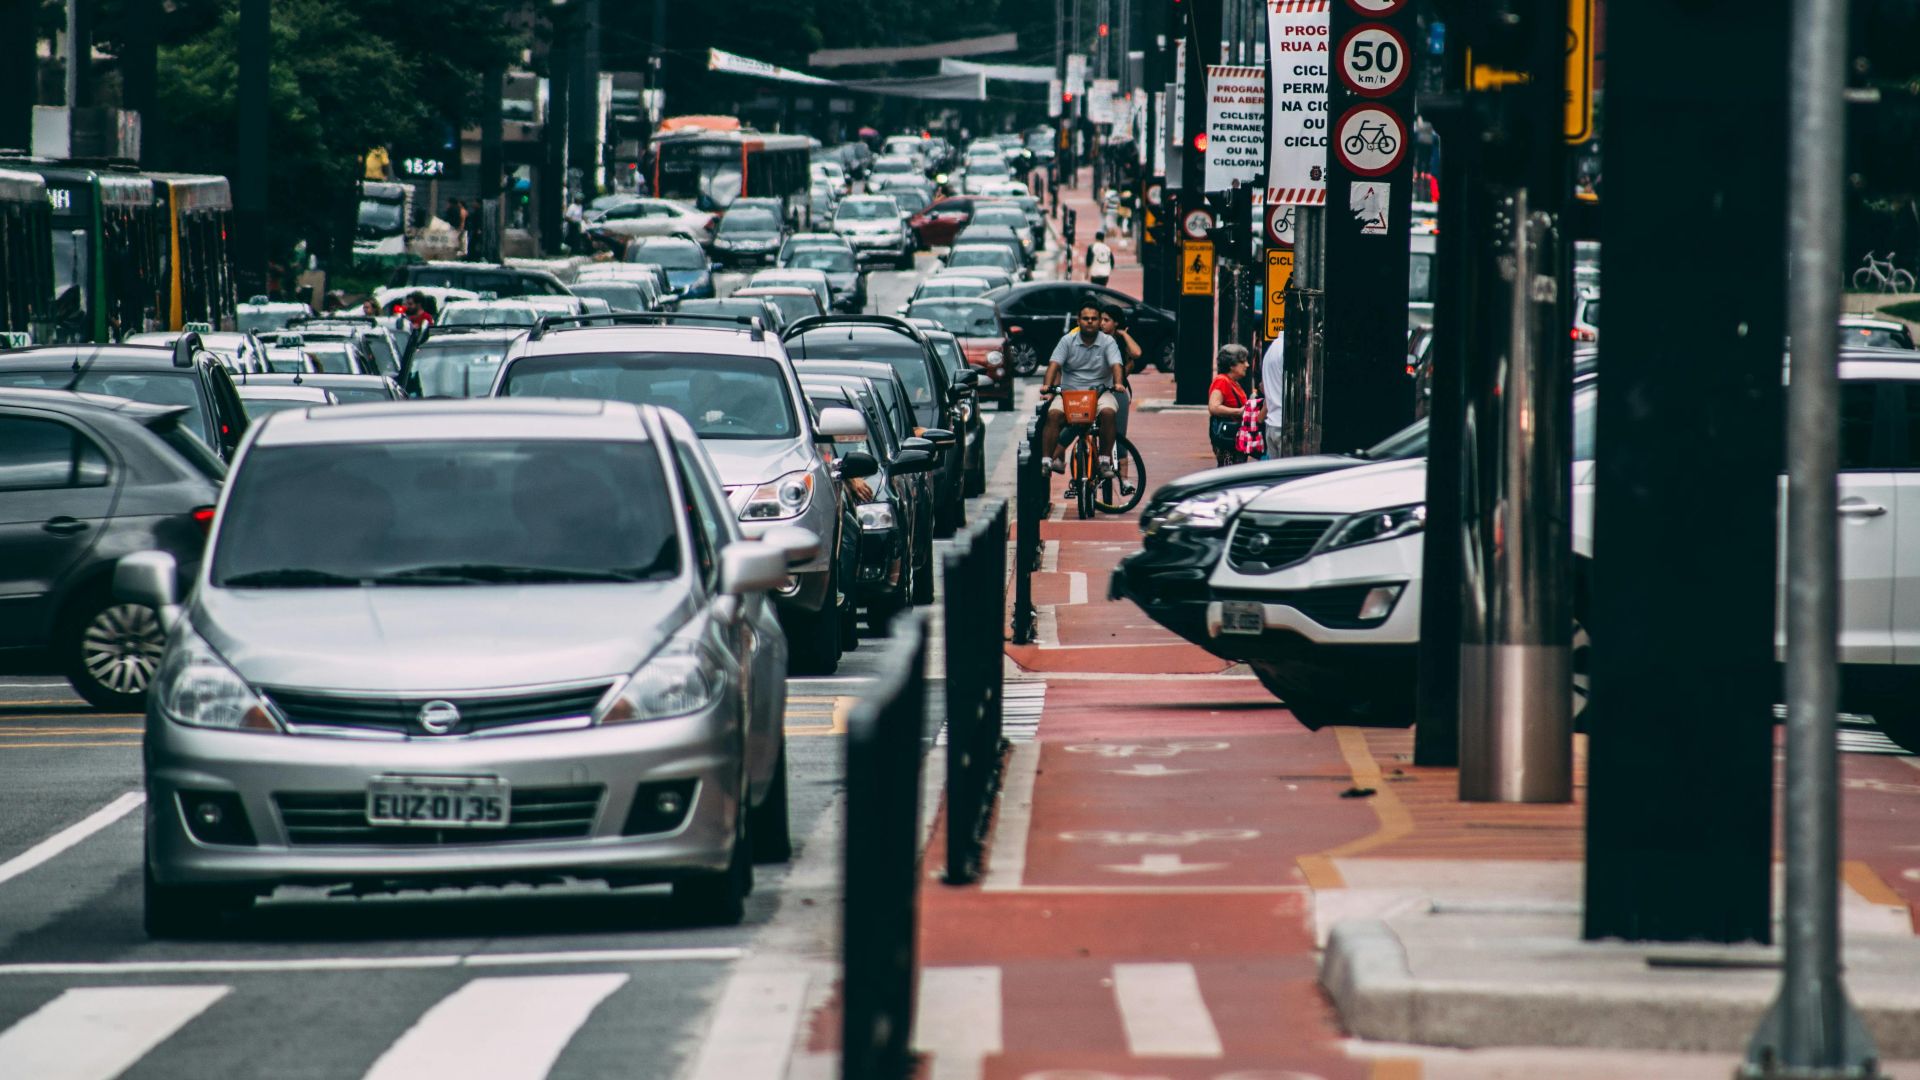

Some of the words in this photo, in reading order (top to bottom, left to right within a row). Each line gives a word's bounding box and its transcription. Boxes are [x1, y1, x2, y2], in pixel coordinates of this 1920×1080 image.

[1285, 25, 1328, 36] PROG
[1281, 41, 1312, 52] RUA
[1351, 40, 1398, 73] 50
[1293, 65, 1327, 76] CICL
[1358, 73, 1386, 84] km/h
[1213, 95, 1235, 104] RUA
[1281, 100, 1303, 112] NA
[1303, 118, 1325, 130] OU
[1211, 134, 1226, 143] NA
[1284, 136, 1328, 147] CICLO
[1226, 146, 1242, 155] OU
[1245, 147, 1258, 155] NA
[1269, 257, 1293, 266] CICL
[186, 324, 209, 333] TAXI
[281, 336, 300, 344] TAXI
